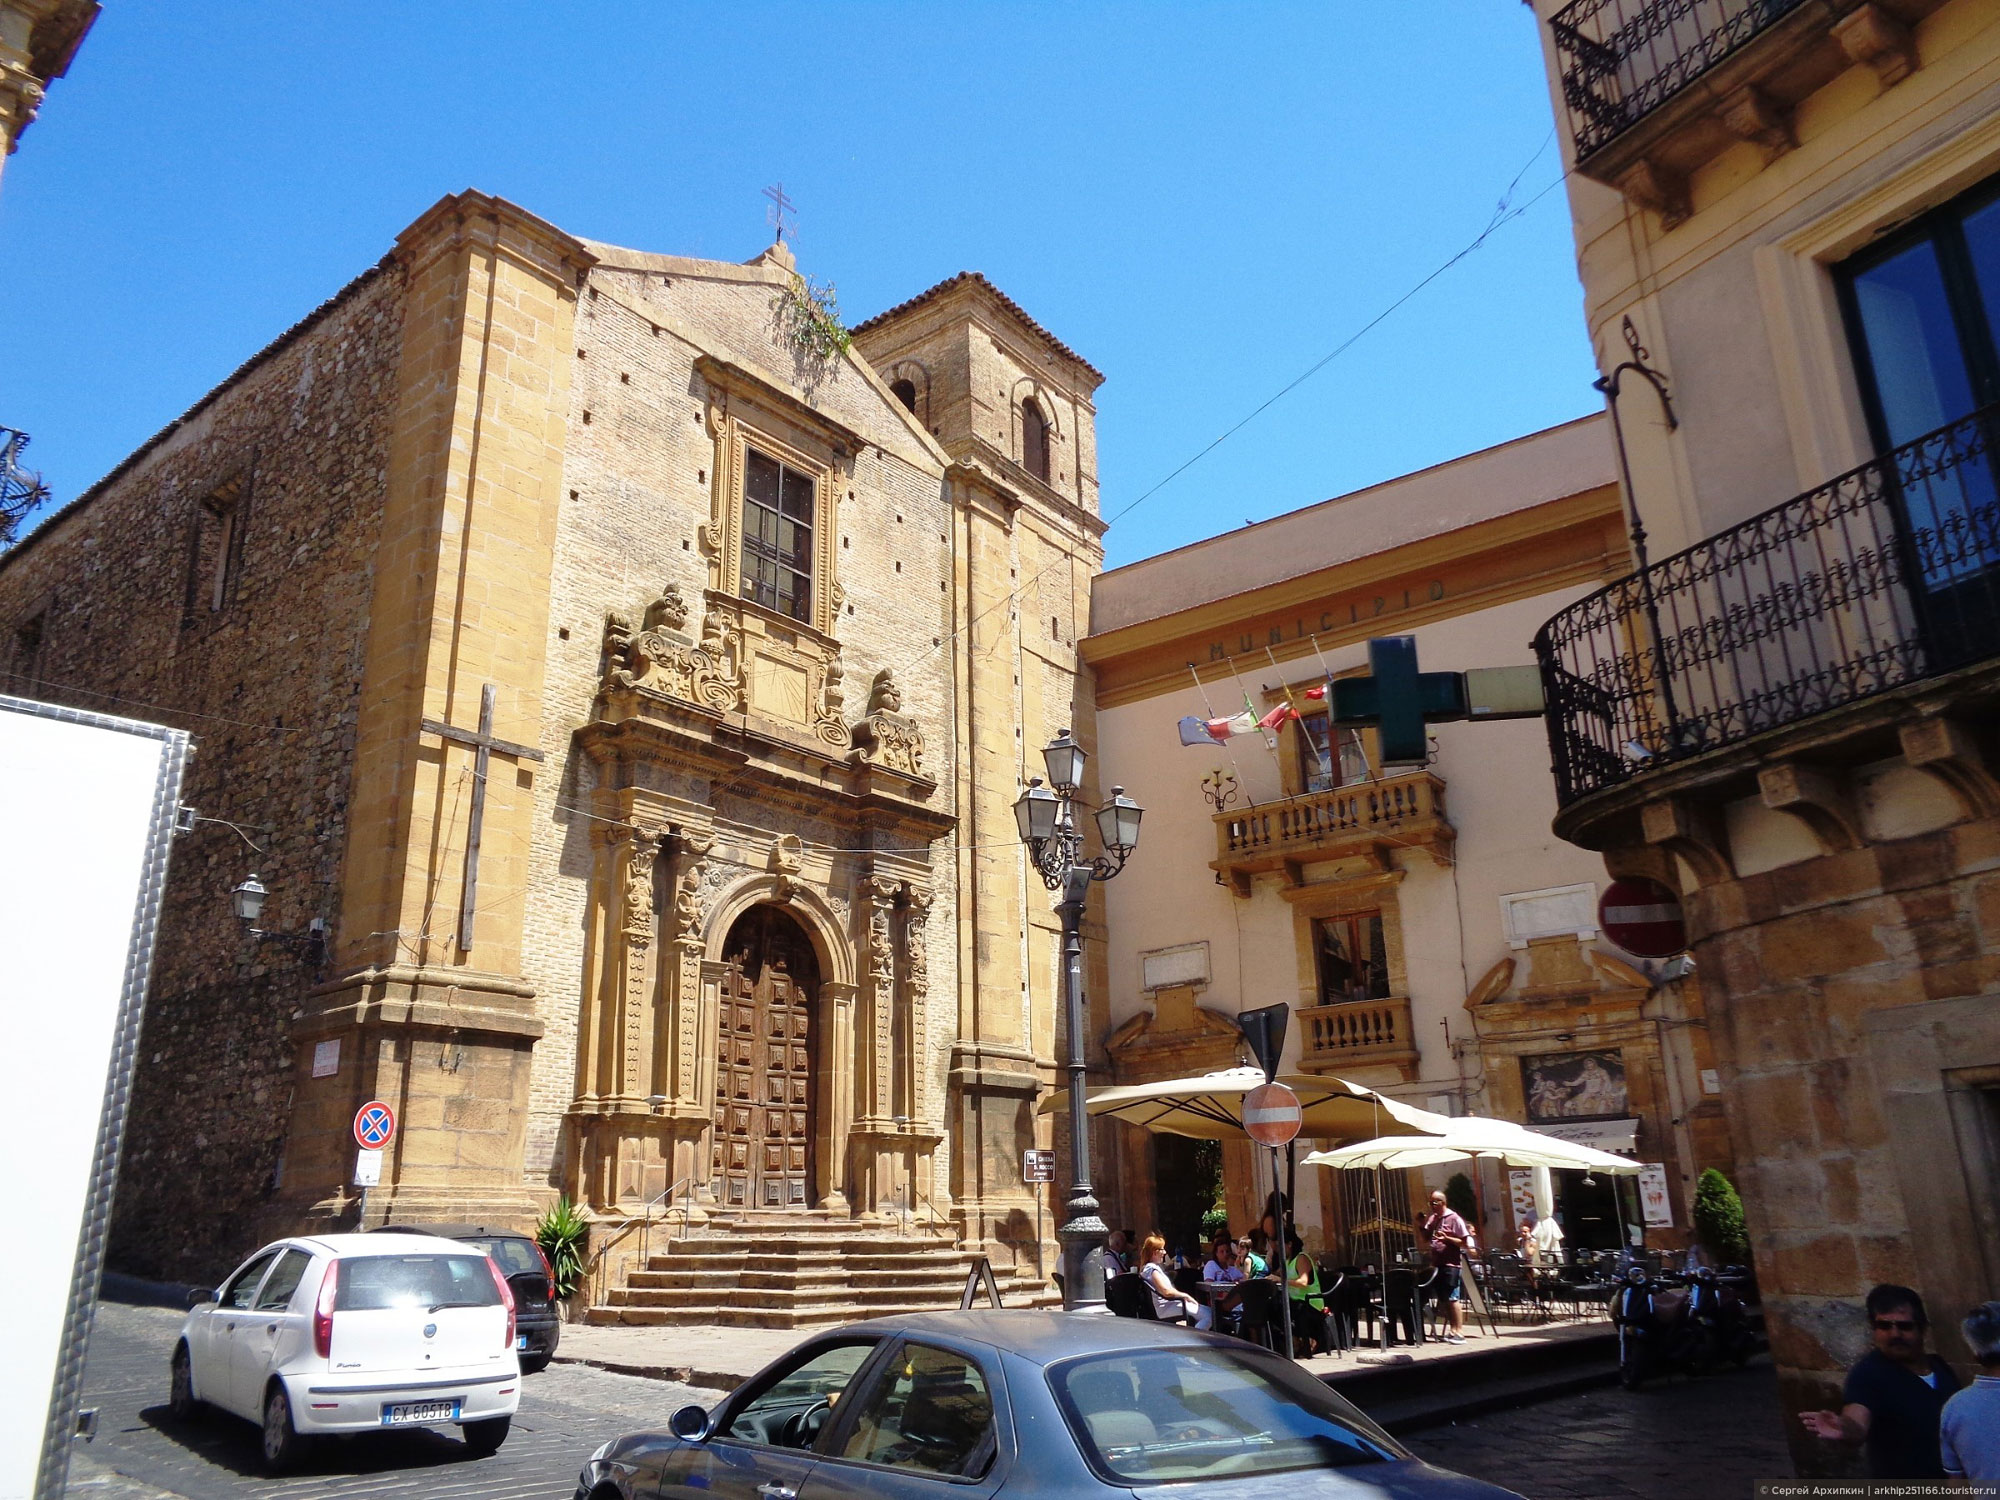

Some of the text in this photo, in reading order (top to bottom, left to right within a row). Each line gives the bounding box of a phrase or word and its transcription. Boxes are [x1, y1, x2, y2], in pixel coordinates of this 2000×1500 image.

[1209, 580, 1444, 661] MUNICIPIO
[393, 1406, 409, 1421] CX
[413, 1403, 452, 1419] 605TB
